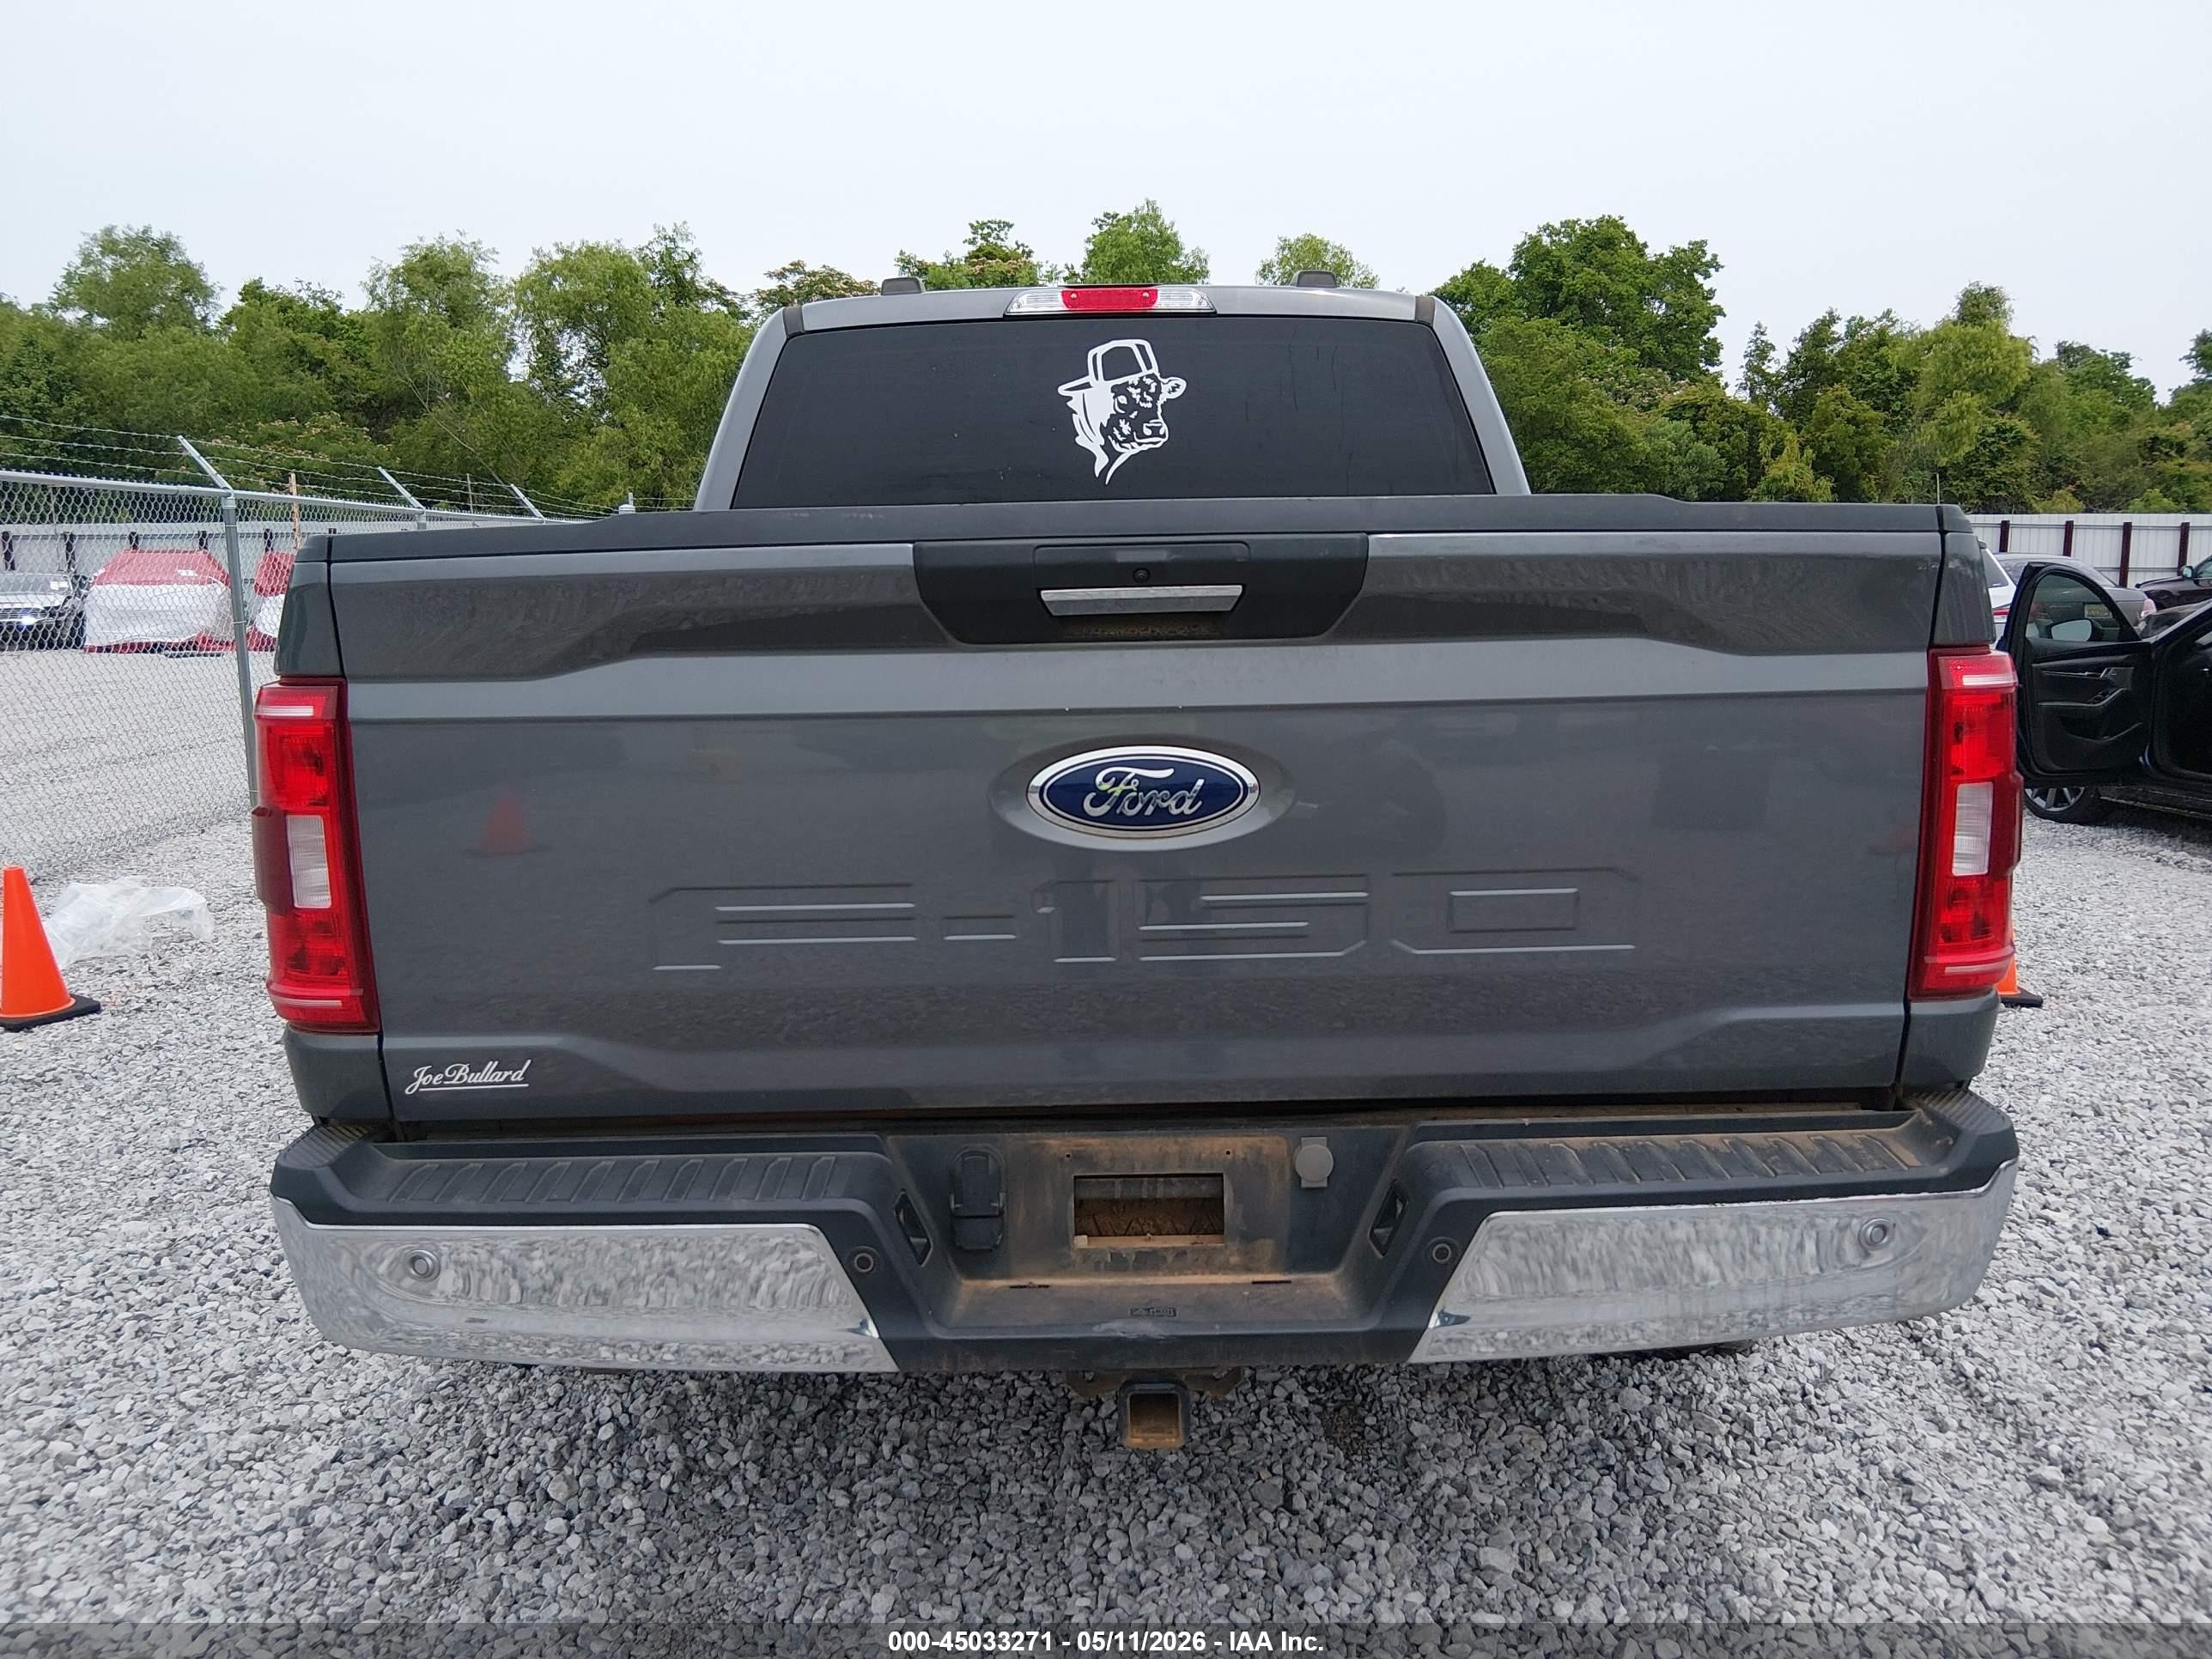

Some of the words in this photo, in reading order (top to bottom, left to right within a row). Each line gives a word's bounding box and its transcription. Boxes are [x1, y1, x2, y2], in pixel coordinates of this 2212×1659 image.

[1083, 766, 1205, 817] Ford
[647, 866, 1640, 971] F-150
[404, 1065, 444, 1095] Joe
[443, 1059, 532, 1085] Bullard
